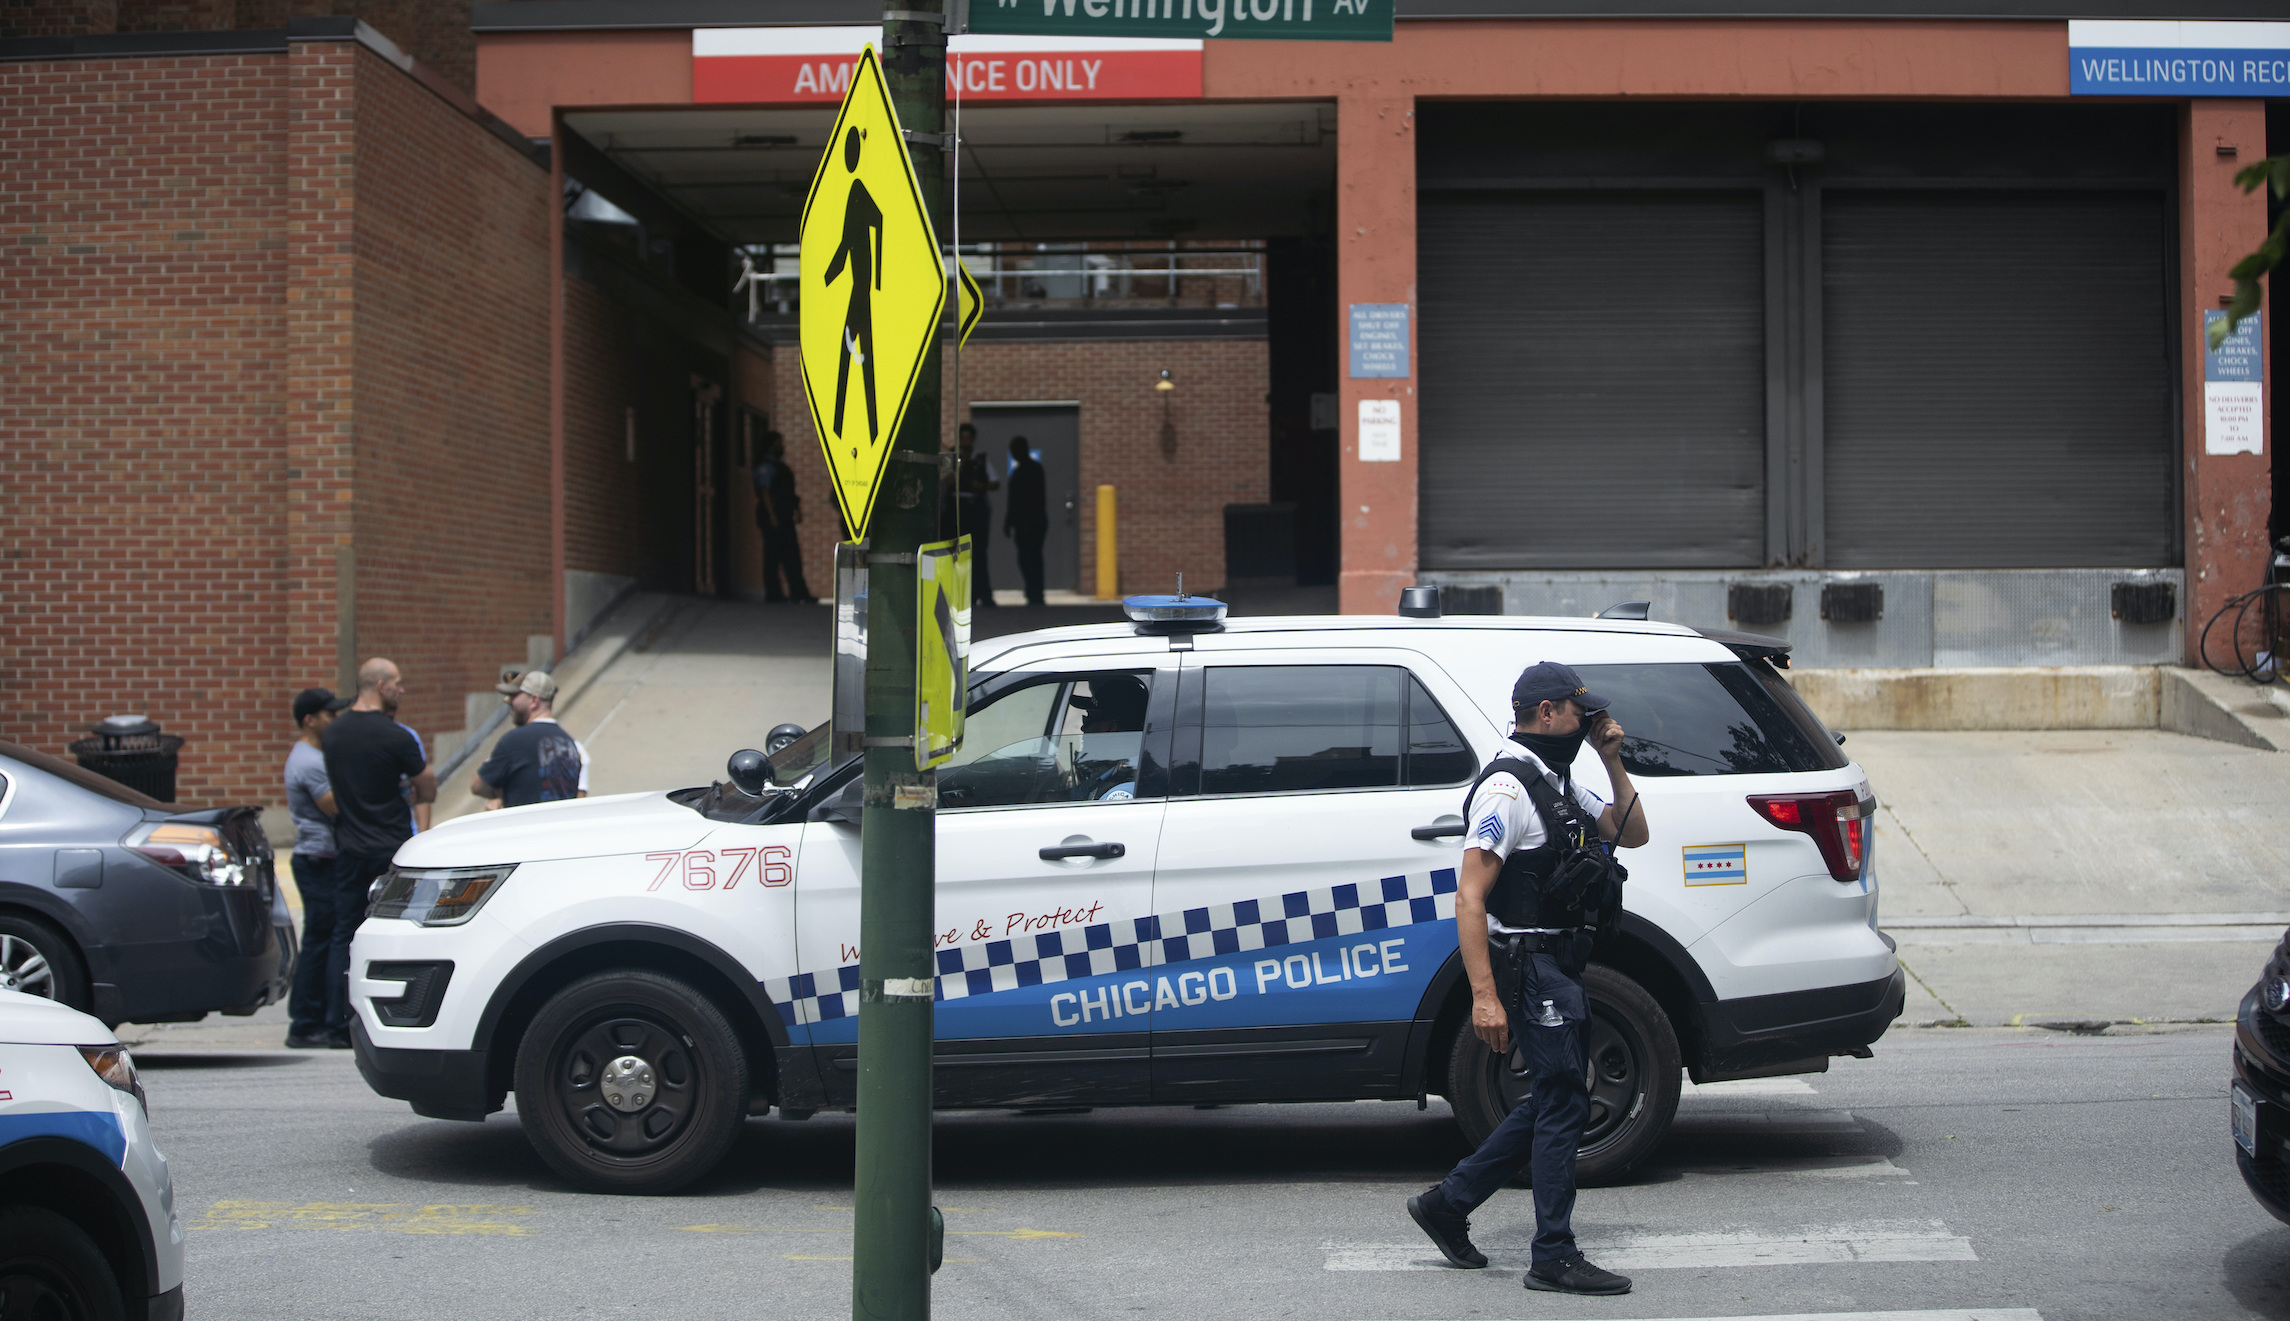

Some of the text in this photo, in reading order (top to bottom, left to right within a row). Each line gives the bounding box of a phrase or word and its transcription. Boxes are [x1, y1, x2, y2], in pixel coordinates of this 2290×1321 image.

[794, 59, 1102, 93] AMNCE ONLY
[2081, 58, 2235, 83] WELLINGTON
[2238, 326, 2253, 335] OFF
[2218, 357, 2248, 365] CHOCK
[2218, 367, 2250, 375] WHEELS
[645, 845, 792, 892] 7676
[841, 943, 861, 962] W
[970, 919, 993, 941] &
[1006, 900, 1104, 936] Protect
[1050, 938, 1409, 1027] CHICAGO POLICE
